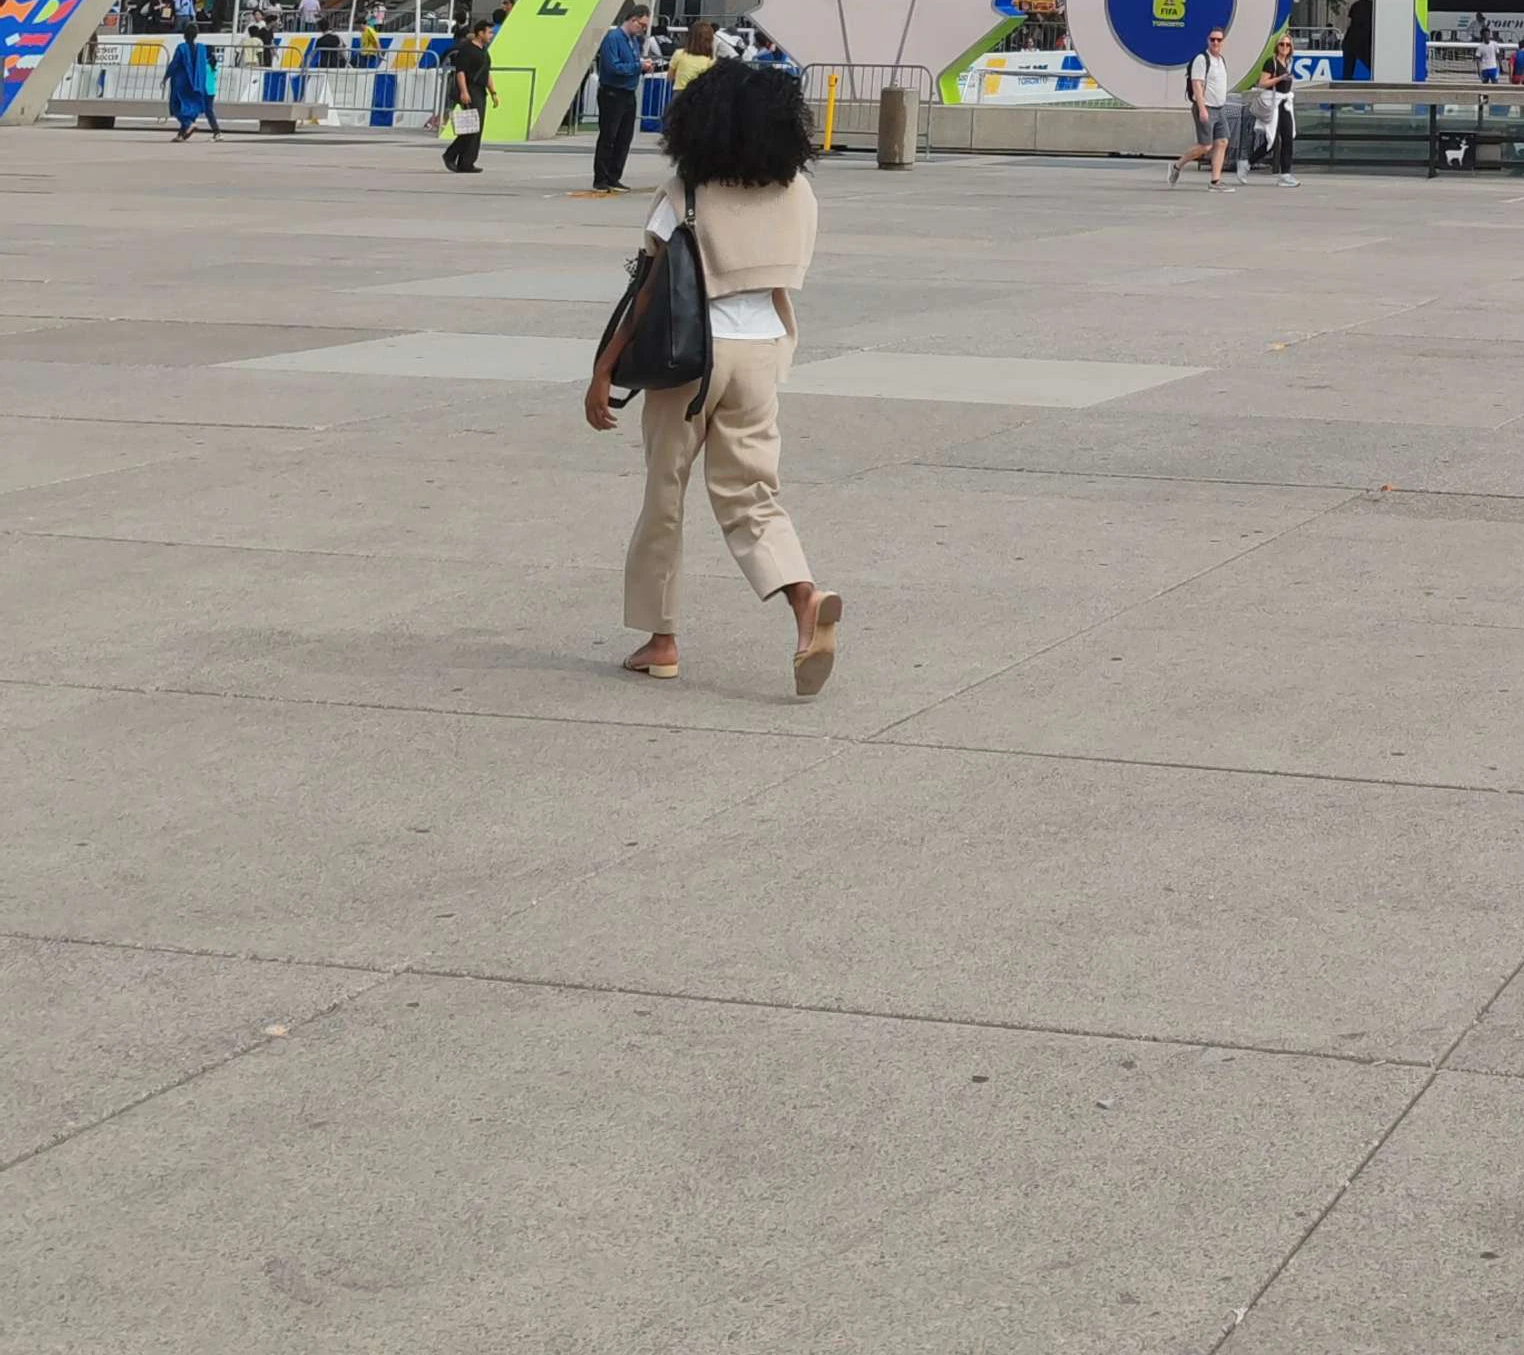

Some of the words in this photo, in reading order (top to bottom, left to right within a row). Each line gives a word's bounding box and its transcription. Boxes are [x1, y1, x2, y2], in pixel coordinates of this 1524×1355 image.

[1160, 7, 1178, 16] FIFA
[1486, 18, 1524, 28] rown
[1293, 57, 1333, 81] SA
